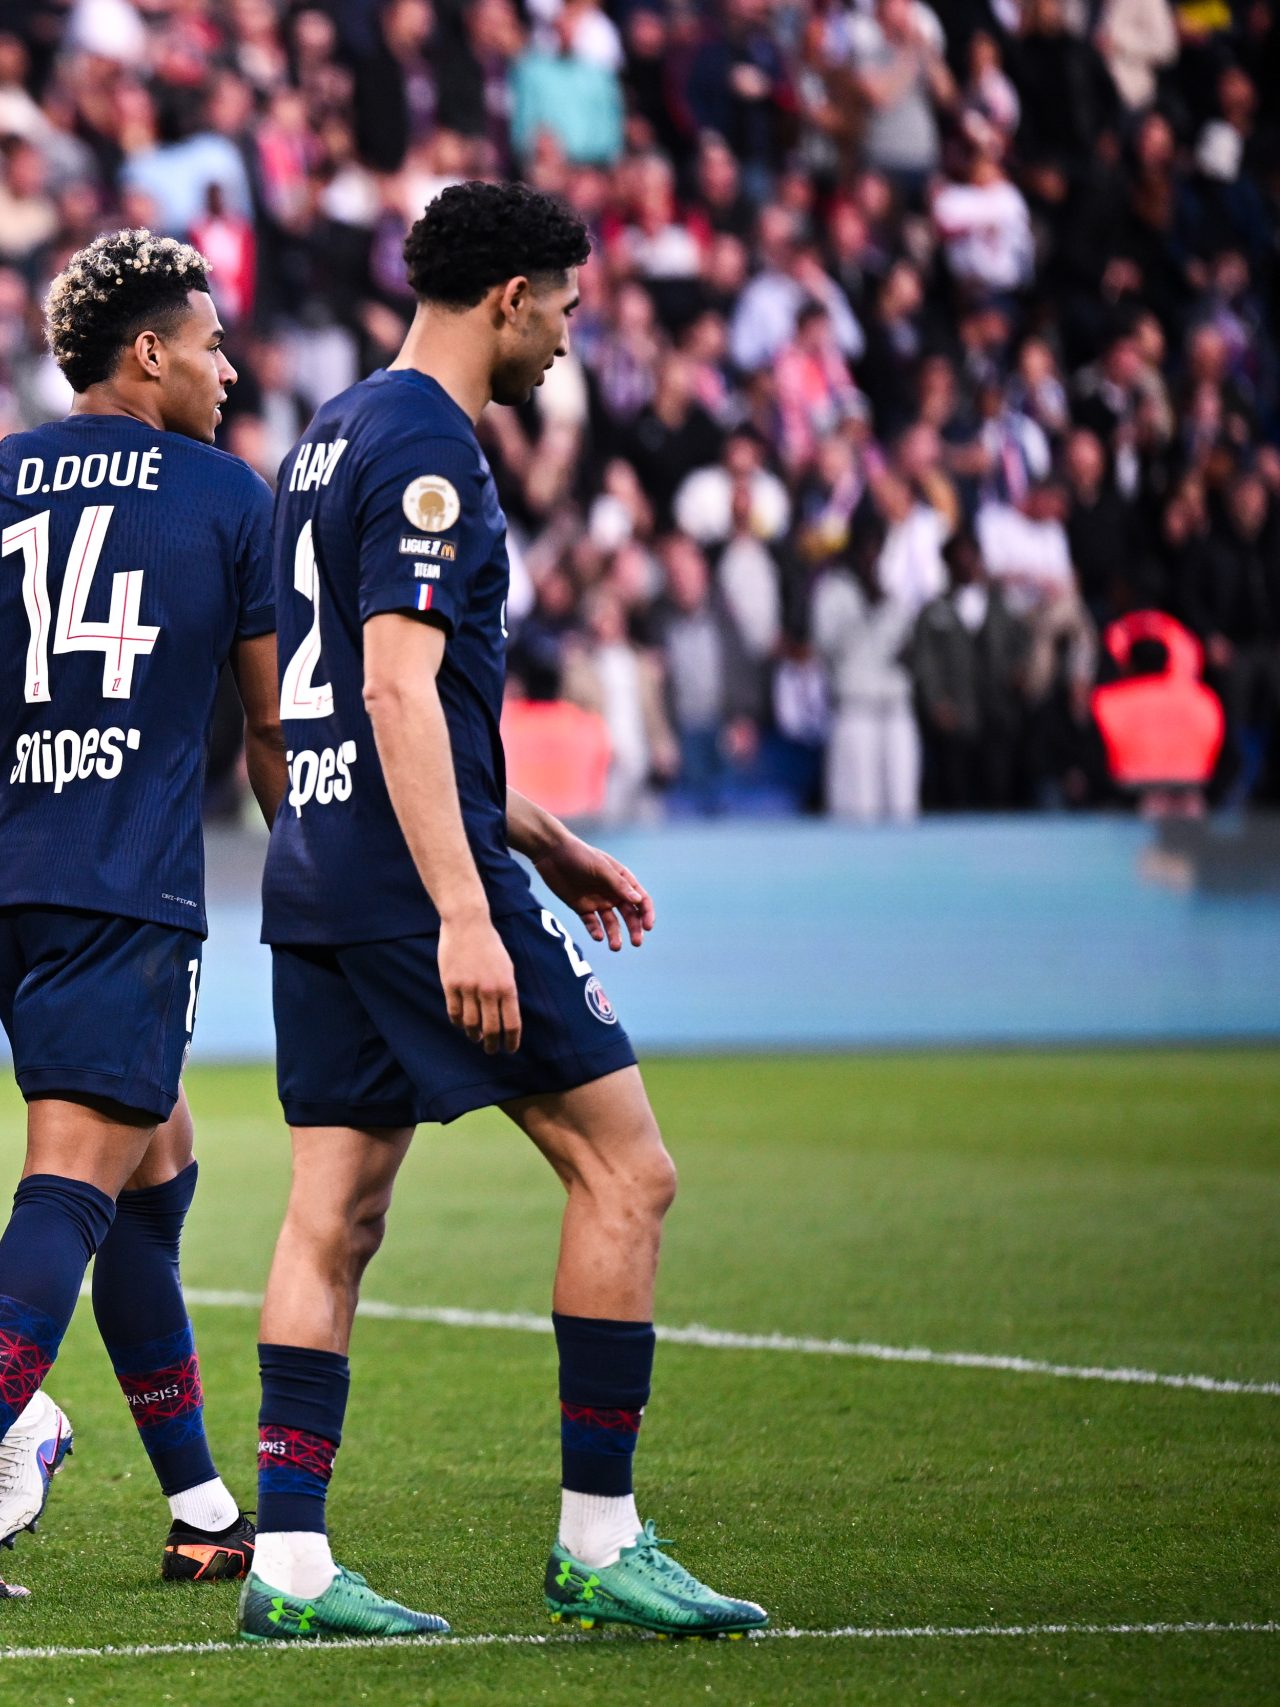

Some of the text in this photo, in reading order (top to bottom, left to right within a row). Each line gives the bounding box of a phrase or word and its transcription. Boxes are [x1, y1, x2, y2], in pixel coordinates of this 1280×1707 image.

[16, 447, 162, 496] D.DOUÉ
[1, 505, 161, 704] 14
[279, 518, 335, 721] 2
[10, 727, 141, 794] snipes
[541, 908, 592, 978] 2
[185, 958, 199, 1034] 1
[125, 1384, 179, 1406] PARIS
